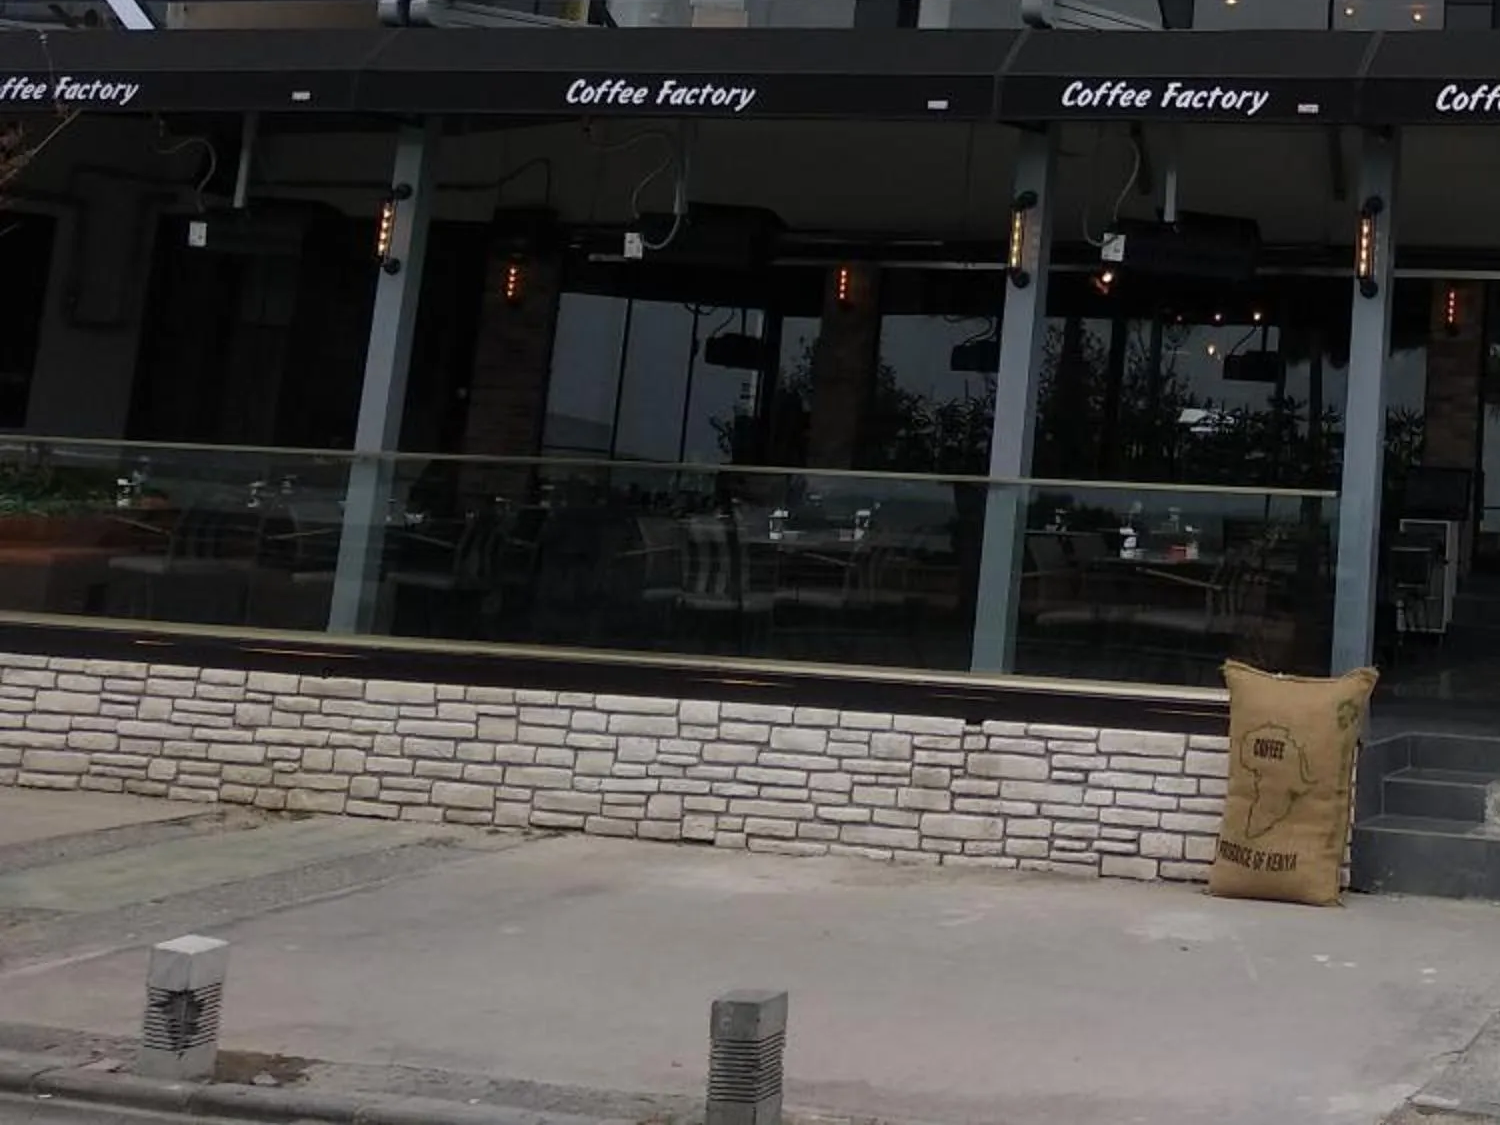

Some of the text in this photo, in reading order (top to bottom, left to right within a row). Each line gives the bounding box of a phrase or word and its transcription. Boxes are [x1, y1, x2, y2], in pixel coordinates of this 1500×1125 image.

[0, 76, 139, 106] ffee Factory
[566, 78, 756, 112] Coffee Factory
[1061, 80, 1269, 116] Coffee Factory
[1253, 738, 1285, 760] COFFEE
